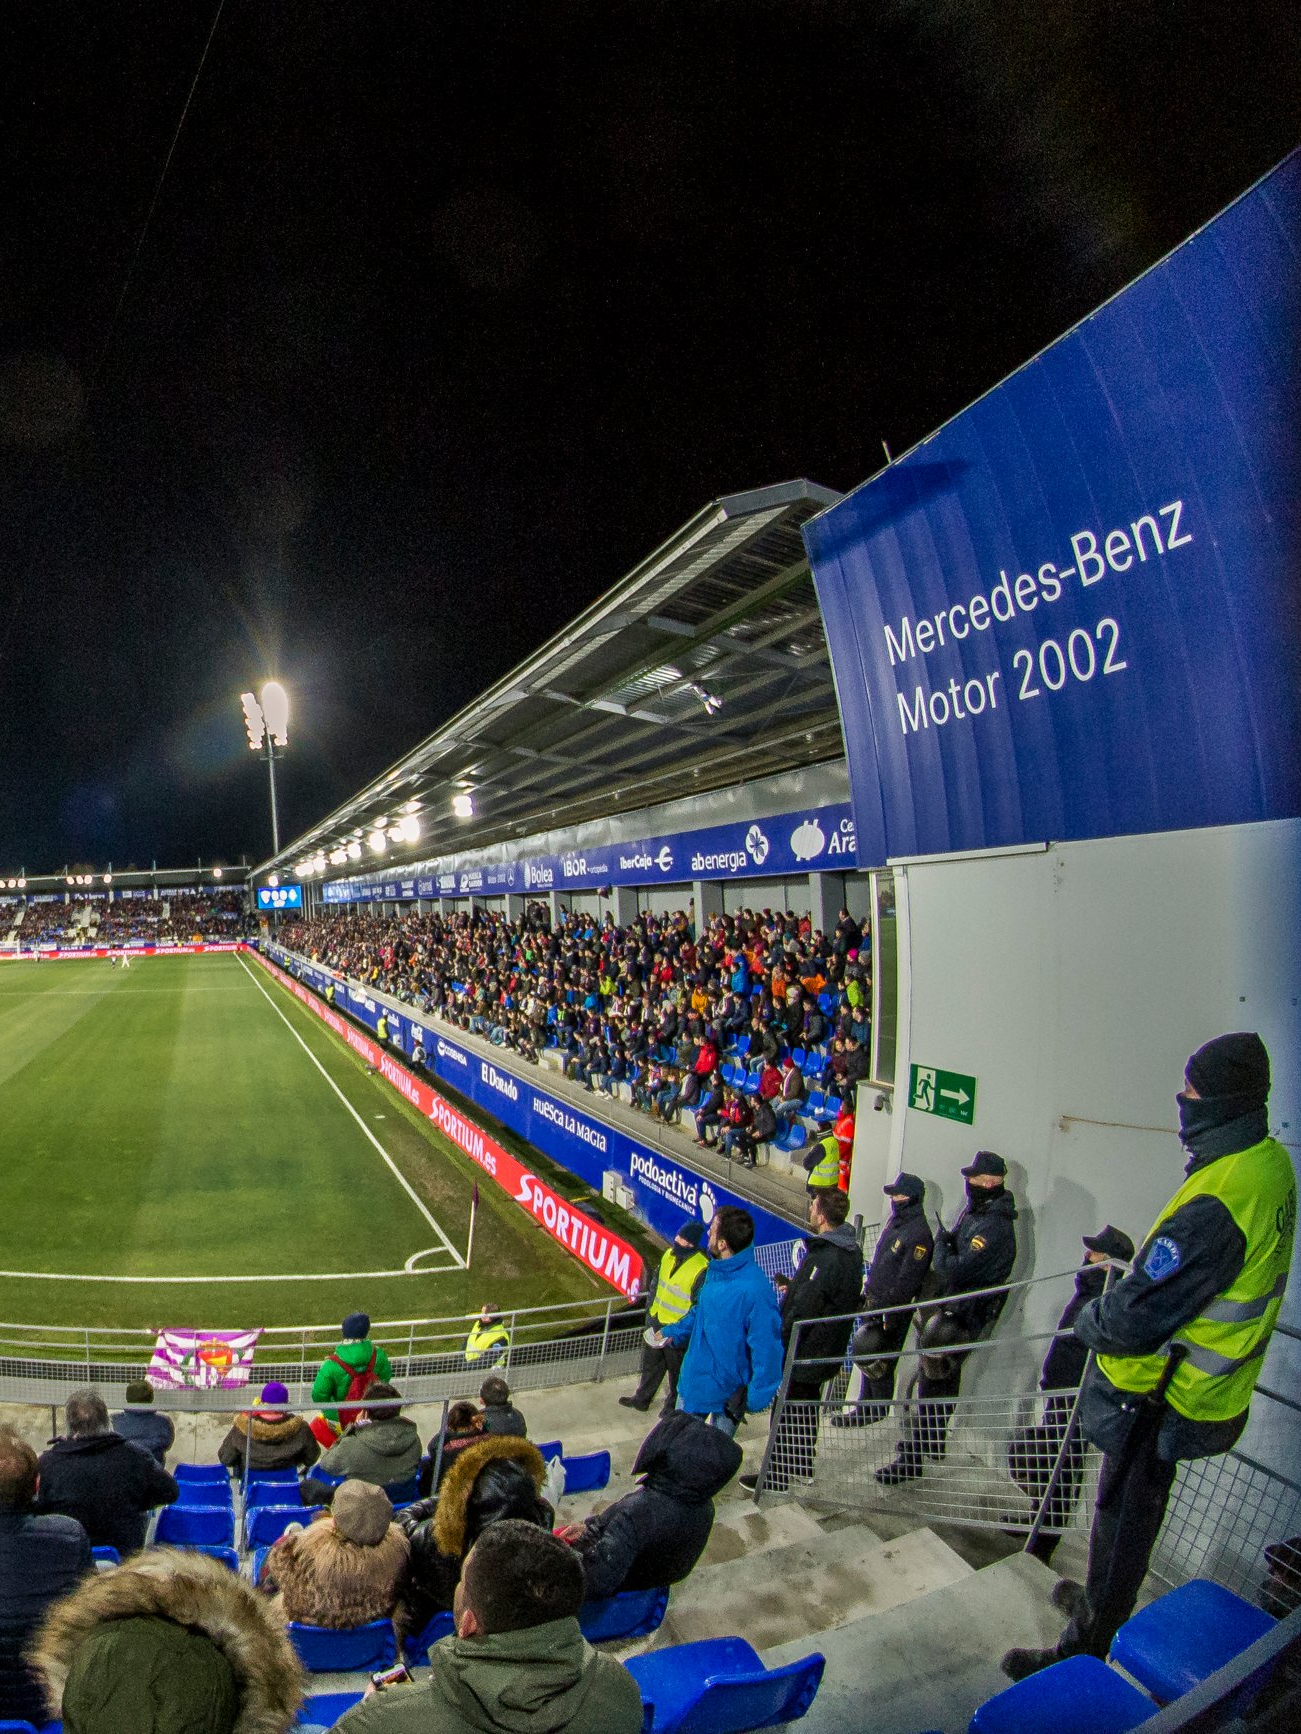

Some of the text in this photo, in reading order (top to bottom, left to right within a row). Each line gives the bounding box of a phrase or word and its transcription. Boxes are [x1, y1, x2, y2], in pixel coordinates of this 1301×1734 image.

[883, 500, 1193, 666] Mercedes-Benz
[896, 617, 1128, 735] Motor 2002
[531, 863, 554, 884] Bolea
[563, 858, 587, 877] IBOR
[691, 851, 747, 872] abenergia
[380, 1053, 420, 1105] SPORTIUM.es
[429, 1096, 497, 1176] SPORTIUM.es
[630, 1152, 697, 1207] podoactiva
